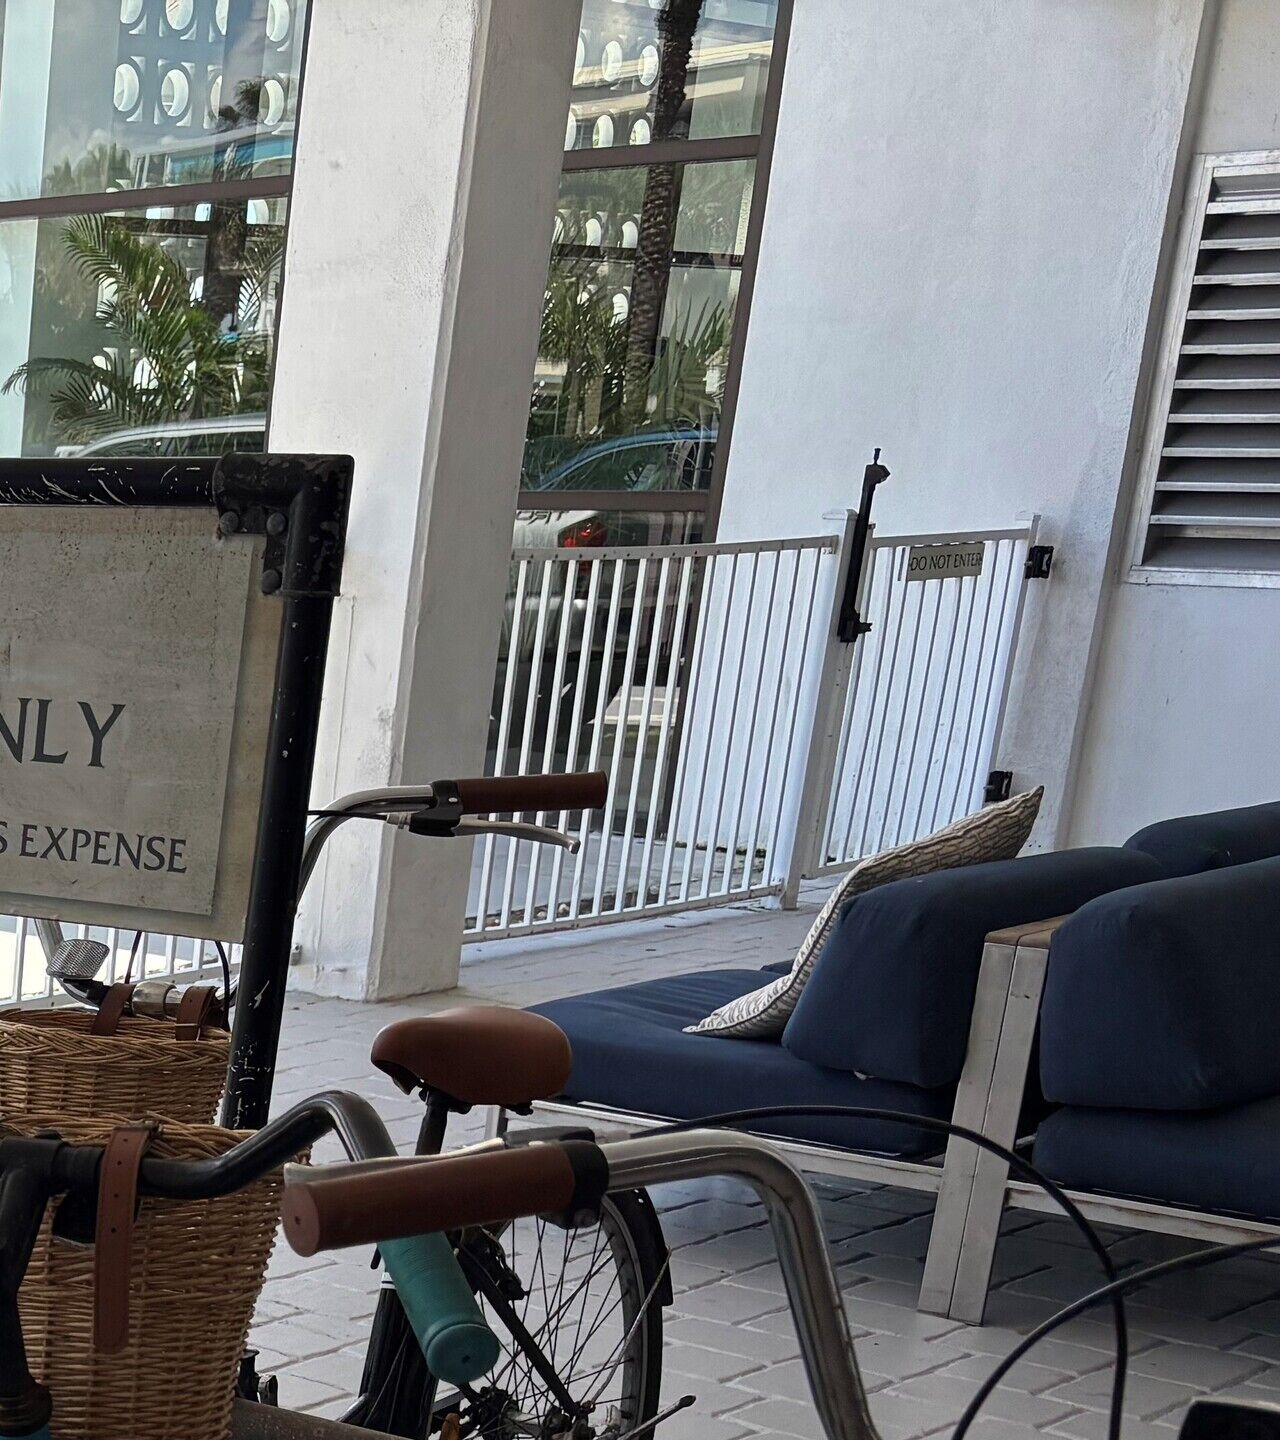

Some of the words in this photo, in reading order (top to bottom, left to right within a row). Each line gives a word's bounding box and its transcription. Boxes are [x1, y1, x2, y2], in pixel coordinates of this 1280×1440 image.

[910, 556, 928, 571] DO
[929, 554, 952, 570] NOT
[953, 552, 983, 569] ENTER
[19, 824, 188, 875] EXPENSE
